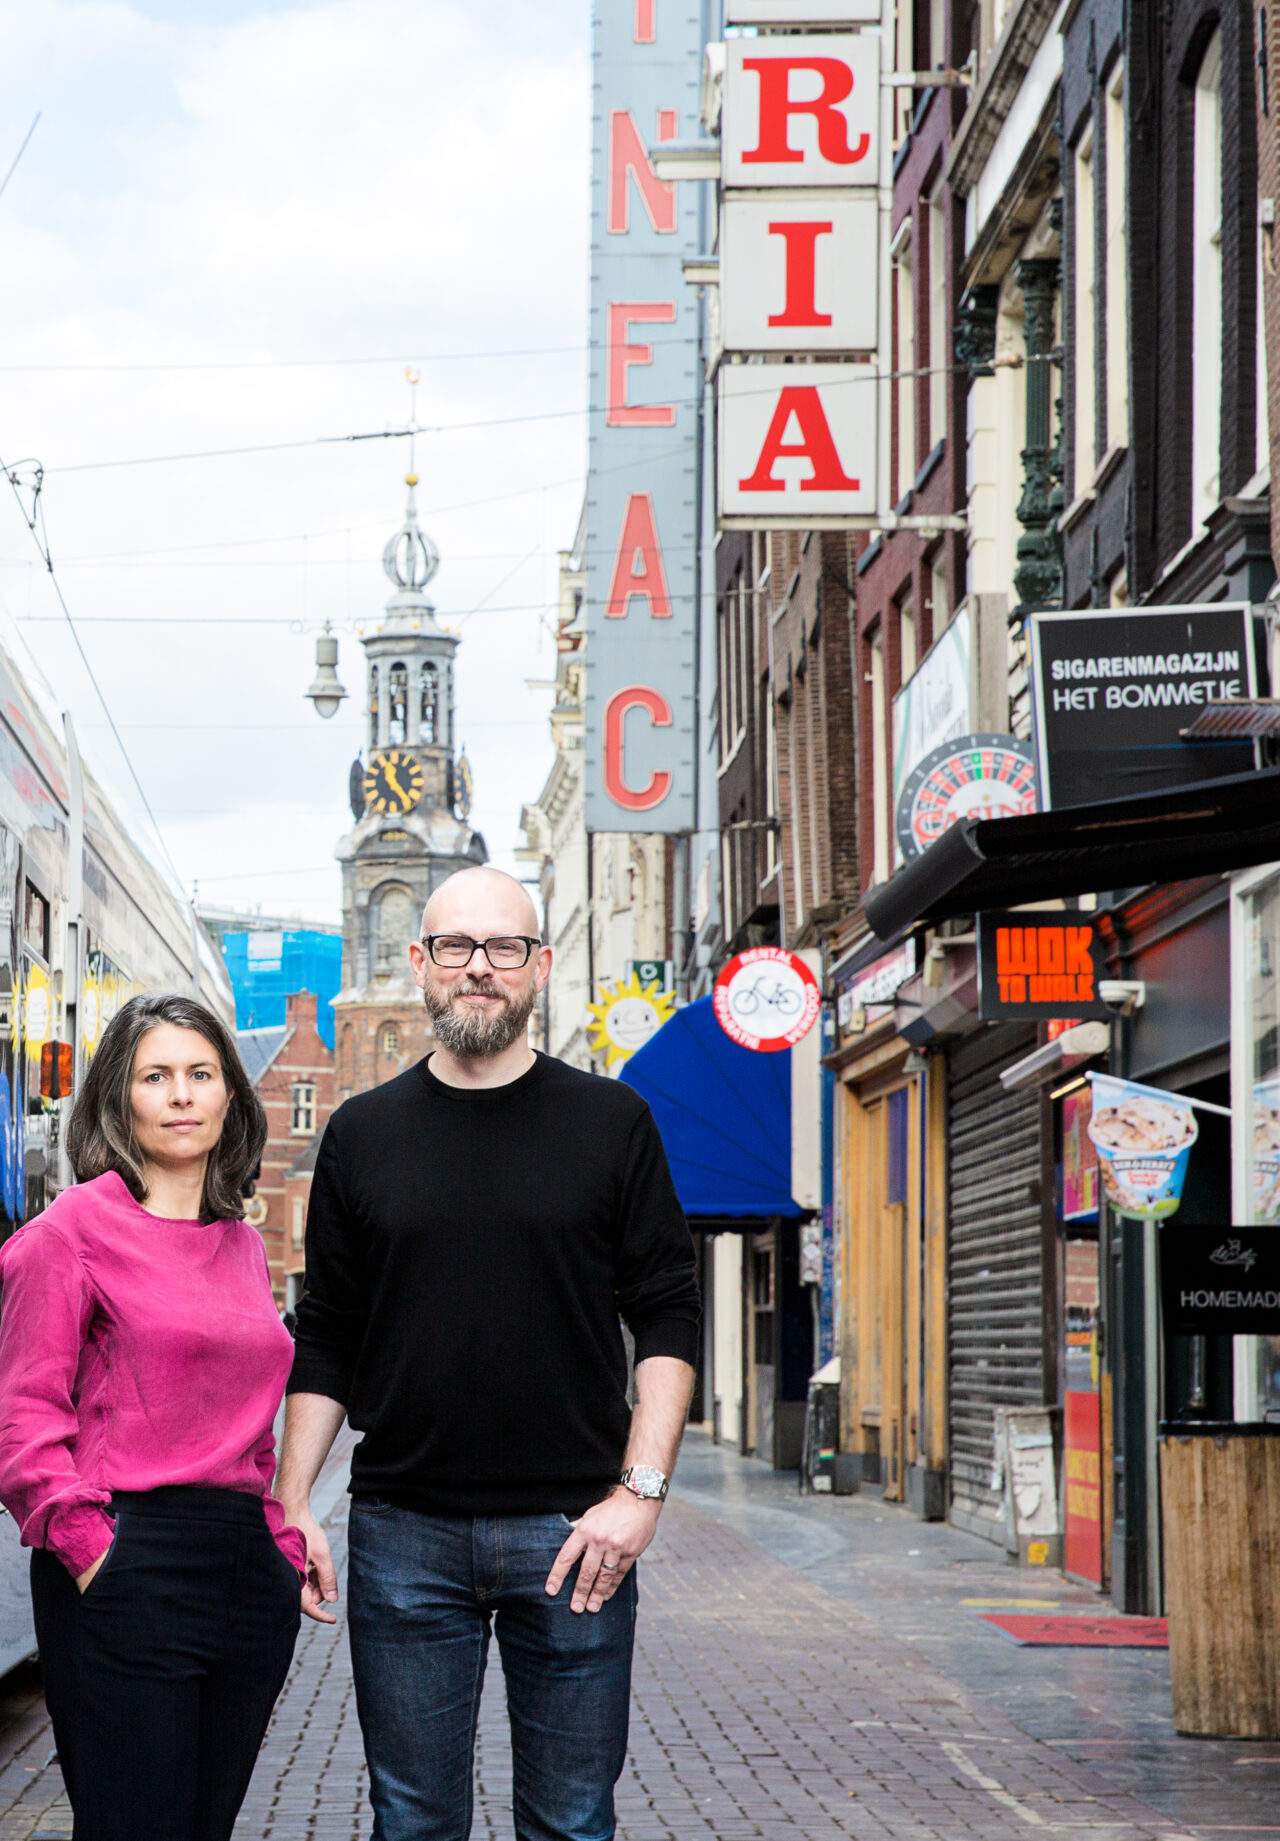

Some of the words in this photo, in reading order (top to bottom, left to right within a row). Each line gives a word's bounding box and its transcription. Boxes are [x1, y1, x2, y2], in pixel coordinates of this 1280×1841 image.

[1051, 650, 1240, 681] SIGARENMAGAZIJN
[1053, 686, 1099, 712] HET
[913, 799, 1038, 842] CASIN
[996, 926, 1094, 975] WOK
[997, 974, 1027, 1003] TO
[1028, 974, 1095, 1003] WALK
[1180, 1290, 1280, 1308] HOMEMAD
